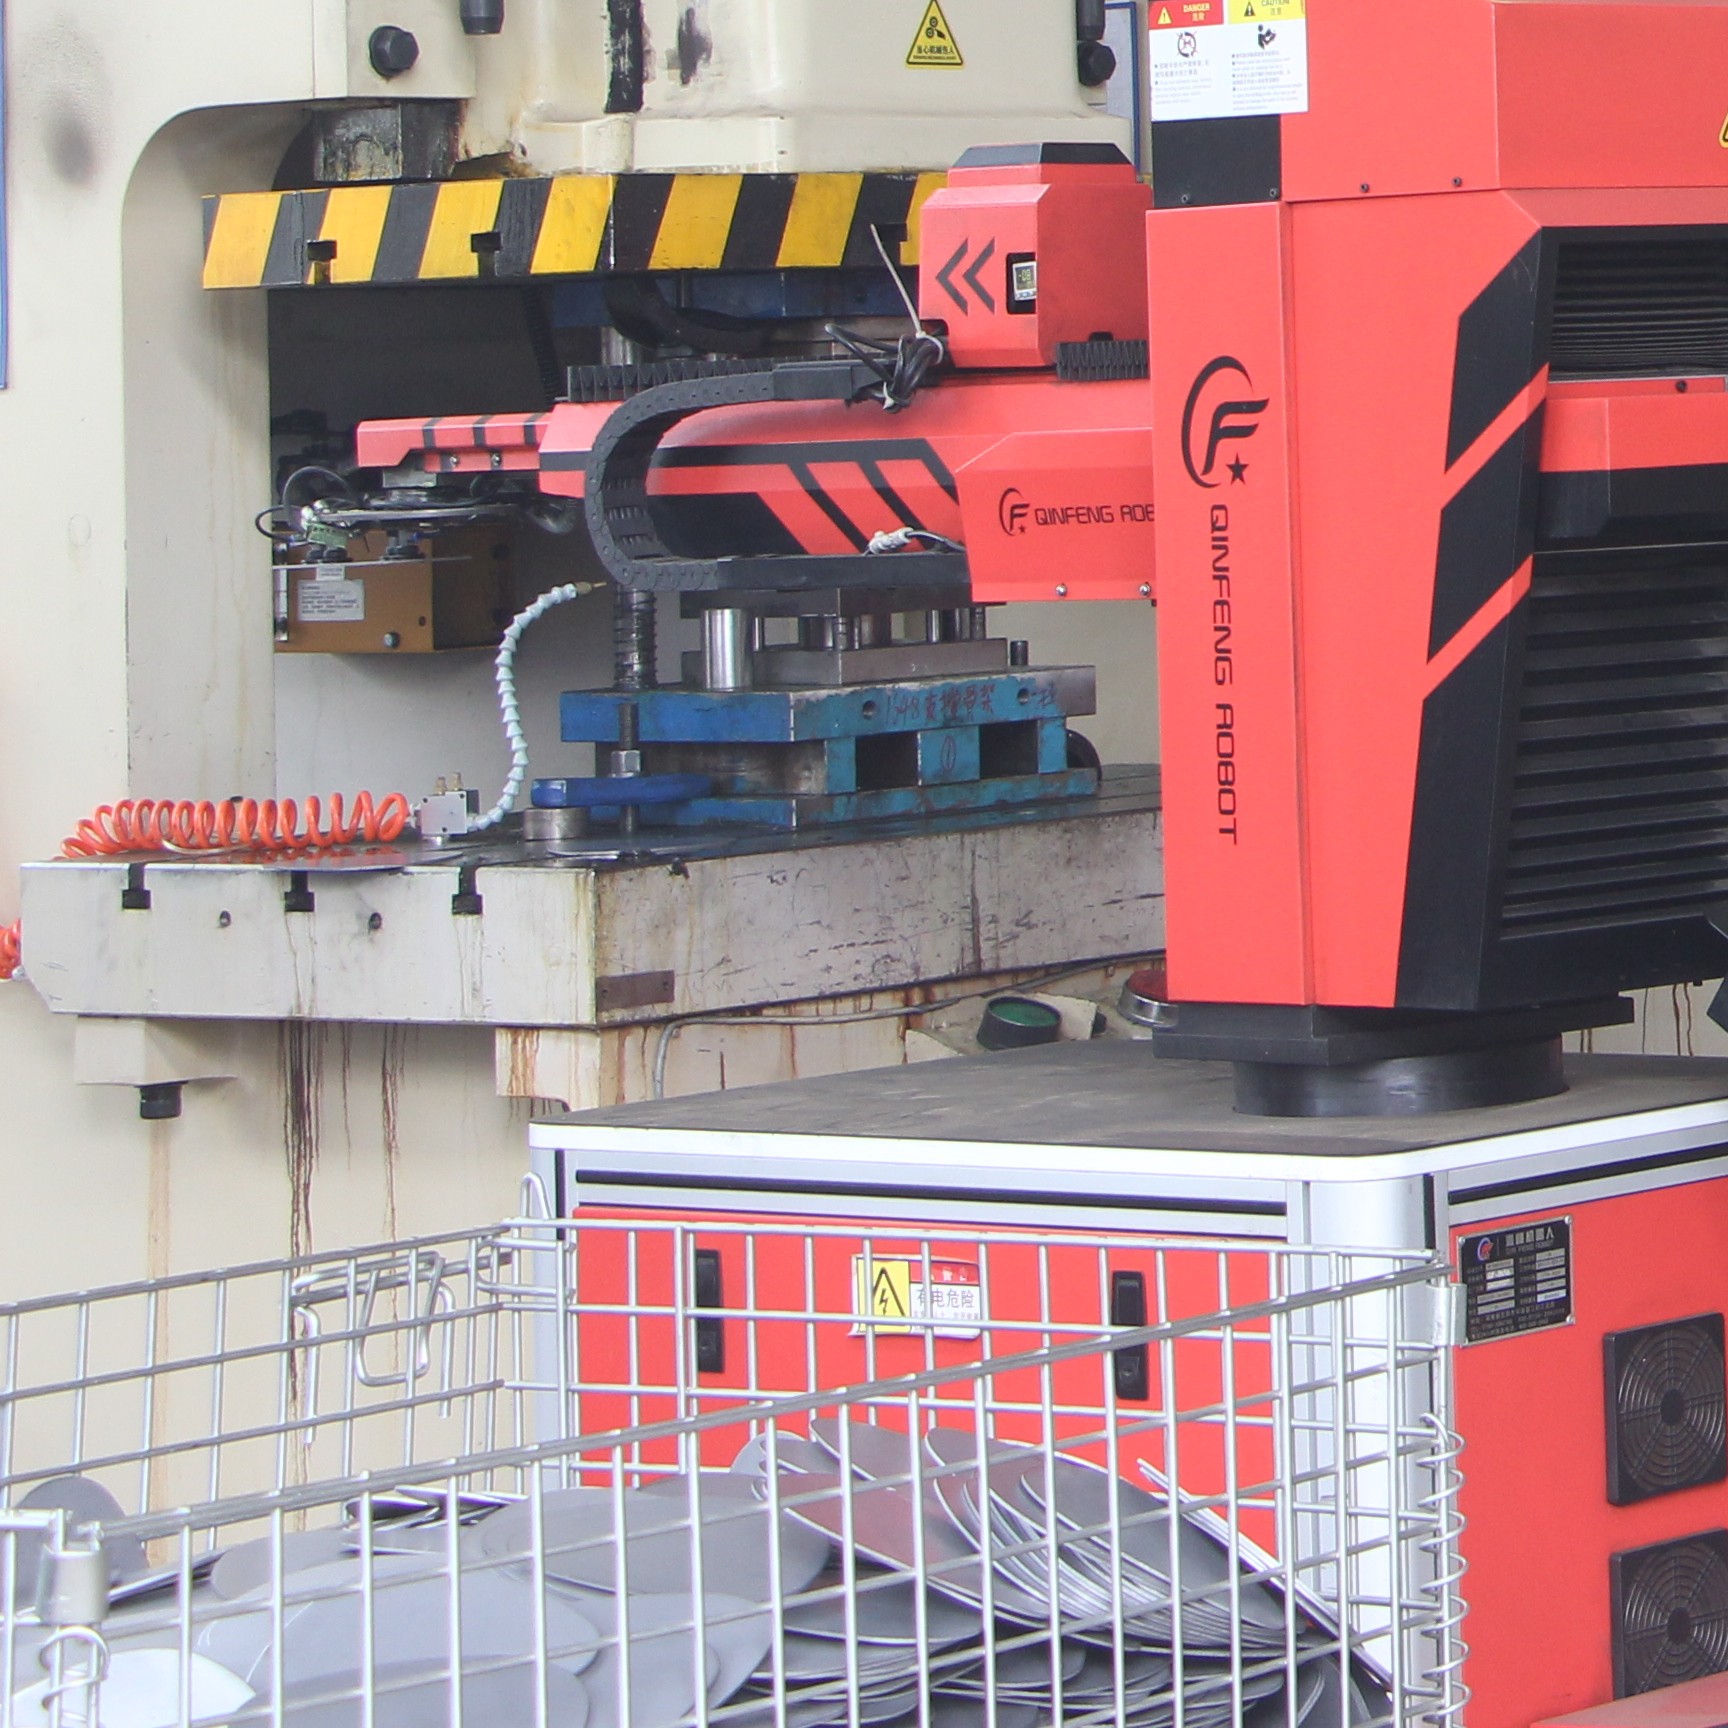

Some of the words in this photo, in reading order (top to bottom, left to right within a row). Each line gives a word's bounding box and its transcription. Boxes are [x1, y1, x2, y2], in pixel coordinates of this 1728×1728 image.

[1182, 2, 1211, 13] DANGER
[1034, 505, 1115, 526] QINFENG
[1209, 504, 1234, 686] QINFENG
[1215, 702, 1238, 846] ROBOT
